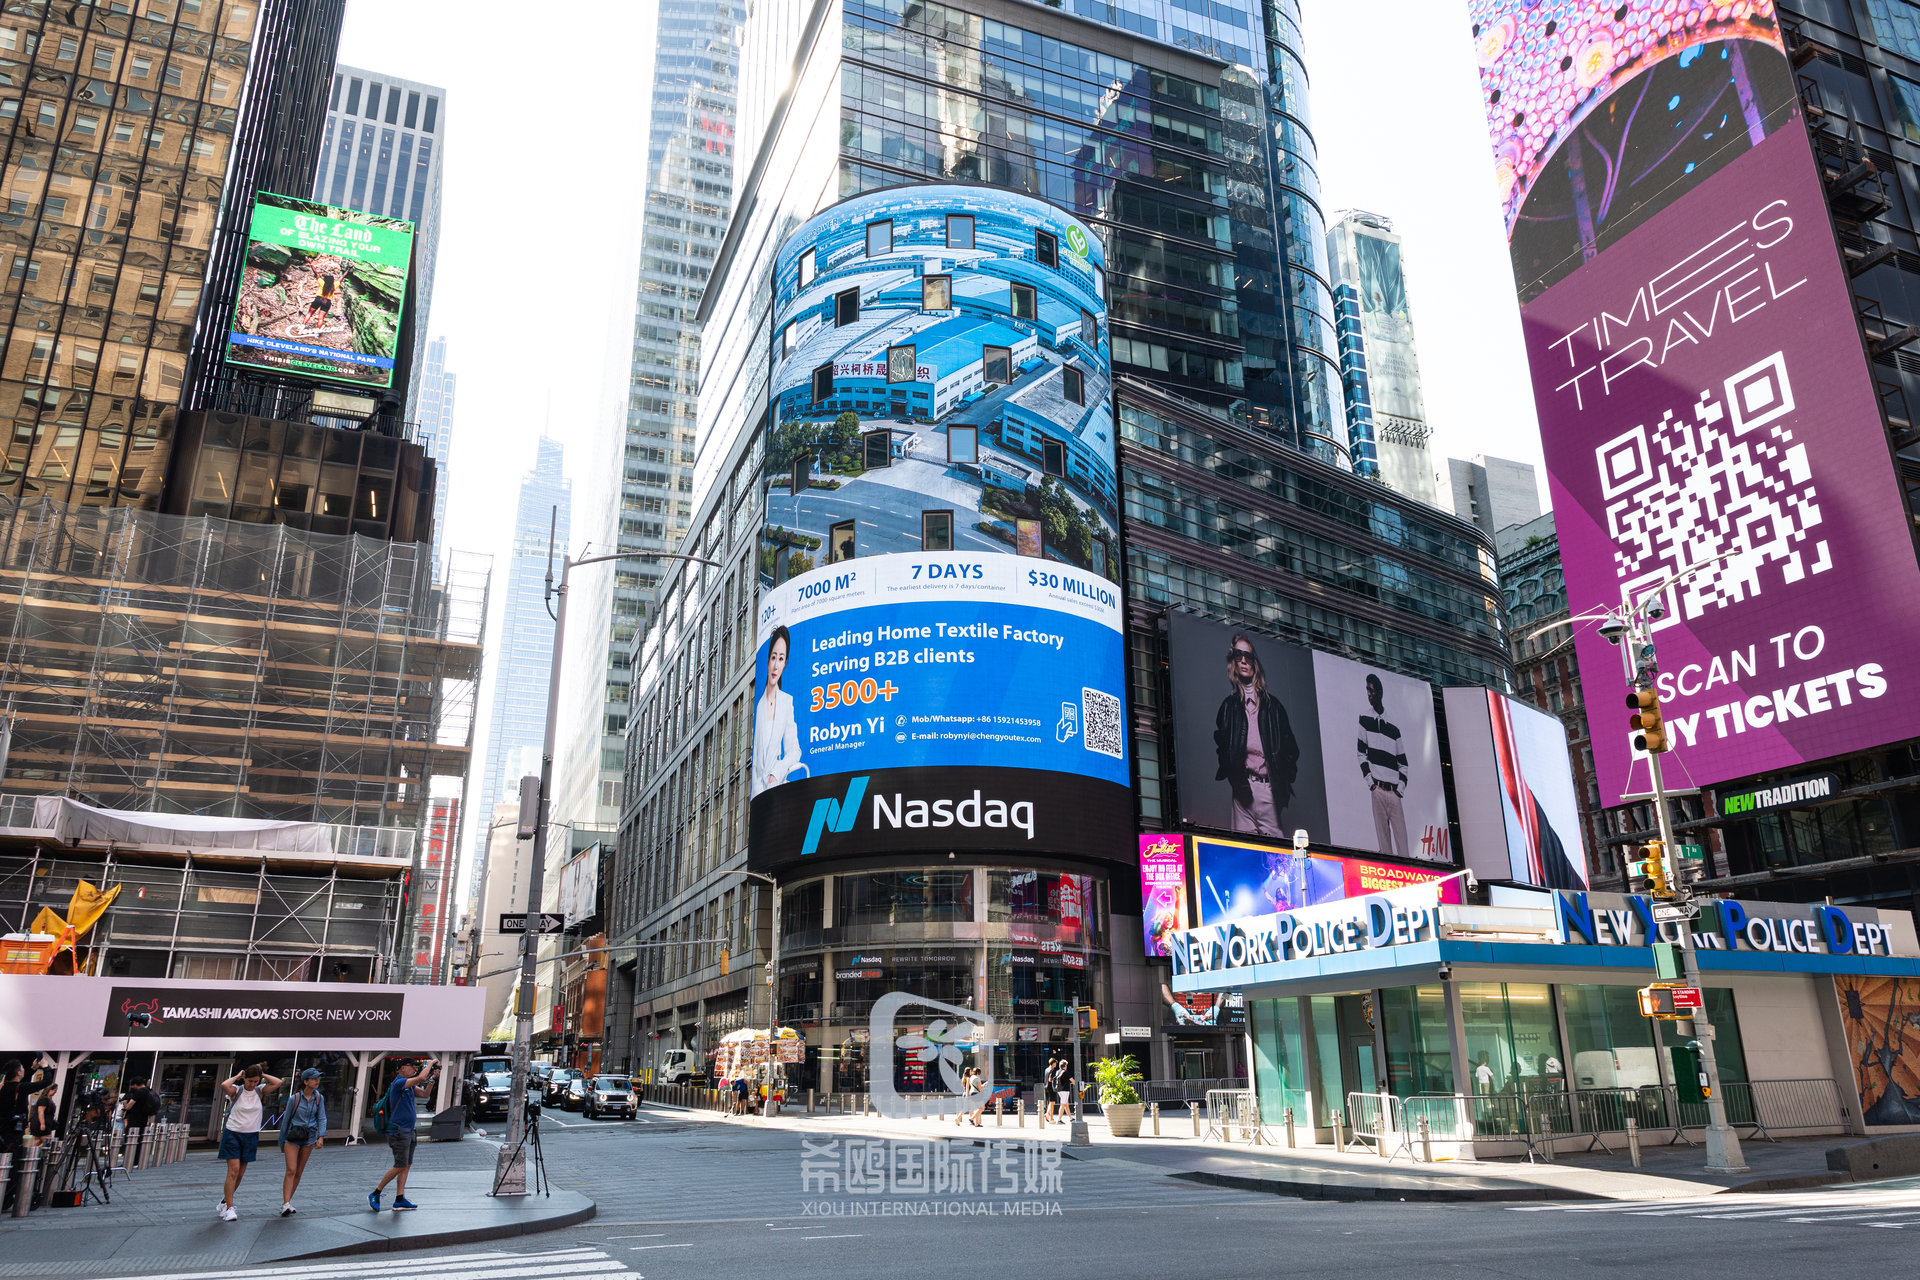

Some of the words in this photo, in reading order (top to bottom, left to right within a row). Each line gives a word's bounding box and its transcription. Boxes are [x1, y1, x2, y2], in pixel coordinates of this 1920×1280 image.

[280, 228, 295, 237] OF
[298, 232, 347, 248] BLAZING
[351, 241, 381, 254] YOUR
[294, 215, 328, 234] The
[334, 222, 373, 242] Land
[298, 240, 324, 251] OWN
[329, 245, 360, 258] TRAIL
[1548, 200, 1793, 368] TIMES
[1555, 262, 1807, 411] TRAVEL
[247, 337, 264, 347] HIKE
[266, 340, 318, 356] CLEVELAND'S
[319, 349, 355, 361] NATIONAL
[357, 355, 376, 364] PARK
[912, 565, 922, 580] 7
[928, 564, 984, 579] DAYS
[798, 579, 831, 602] 7000
[922, 583, 947, 591] delivery
[1028, 569, 1058, 588] $30
[1063, 576, 1116, 610] MILLION
[812, 630, 873, 653] Leading
[878, 625, 932, 641] Home
[935, 622, 998, 638] Textile
[1003, 624, 1064, 650] Factory
[812, 656, 870, 678] Serving
[874, 650, 910, 666] B2B
[914, 648, 975, 663] clients
[1657, 644, 1756, 703] SCAN
[1770, 625, 1825, 668] TO
[810, 678, 899, 712] 3500+
[1706, 663, 1888, 739] TICKETS
[810, 722, 862, 742] Robyn
[866, 716, 885, 734] Yi
[911, 715, 975, 725] Mob/Whatsapp:
[810, 744, 834, 754] General
[835, 740, 866, 752] Manager
[911, 732, 938, 740] E-mail:
[940, 732, 1042, 744] robynyi@chengyoutex.com
[873, 790, 1035, 840] Nasdaq
[428, 808, 447, 866] PARK
[1421, 824, 1448, 860] H&M
[1142, 864, 1158, 872] ENJOY
[1158, 864, 1166, 872] NO
[1166, 864, 1176, 872] FEES
[506, 920, 524, 928] ONE
[1171, 932, 1216, 976] NEW
[1216, 924, 1273, 968] YORK
[1276, 913, 1359, 961] POLICE
[1365, 896, 1439, 948] DEPT
[1553, 889, 1633, 945] NEW
[1718, 900, 1820, 953] POLICE
[1819, 906, 1893, 956] DEPT
[860, 956, 882, 964] Nasdaq
[1012, 956, 1034, 964] Nasdaq
[162, 1007, 222, 1019] TAMASHII
[222, 1007, 278, 1020] NATIONS
[282, 1009, 322, 1021] STORE
[326, 1009, 356, 1020] NEW
[357, 1009, 391, 1020] YORK
